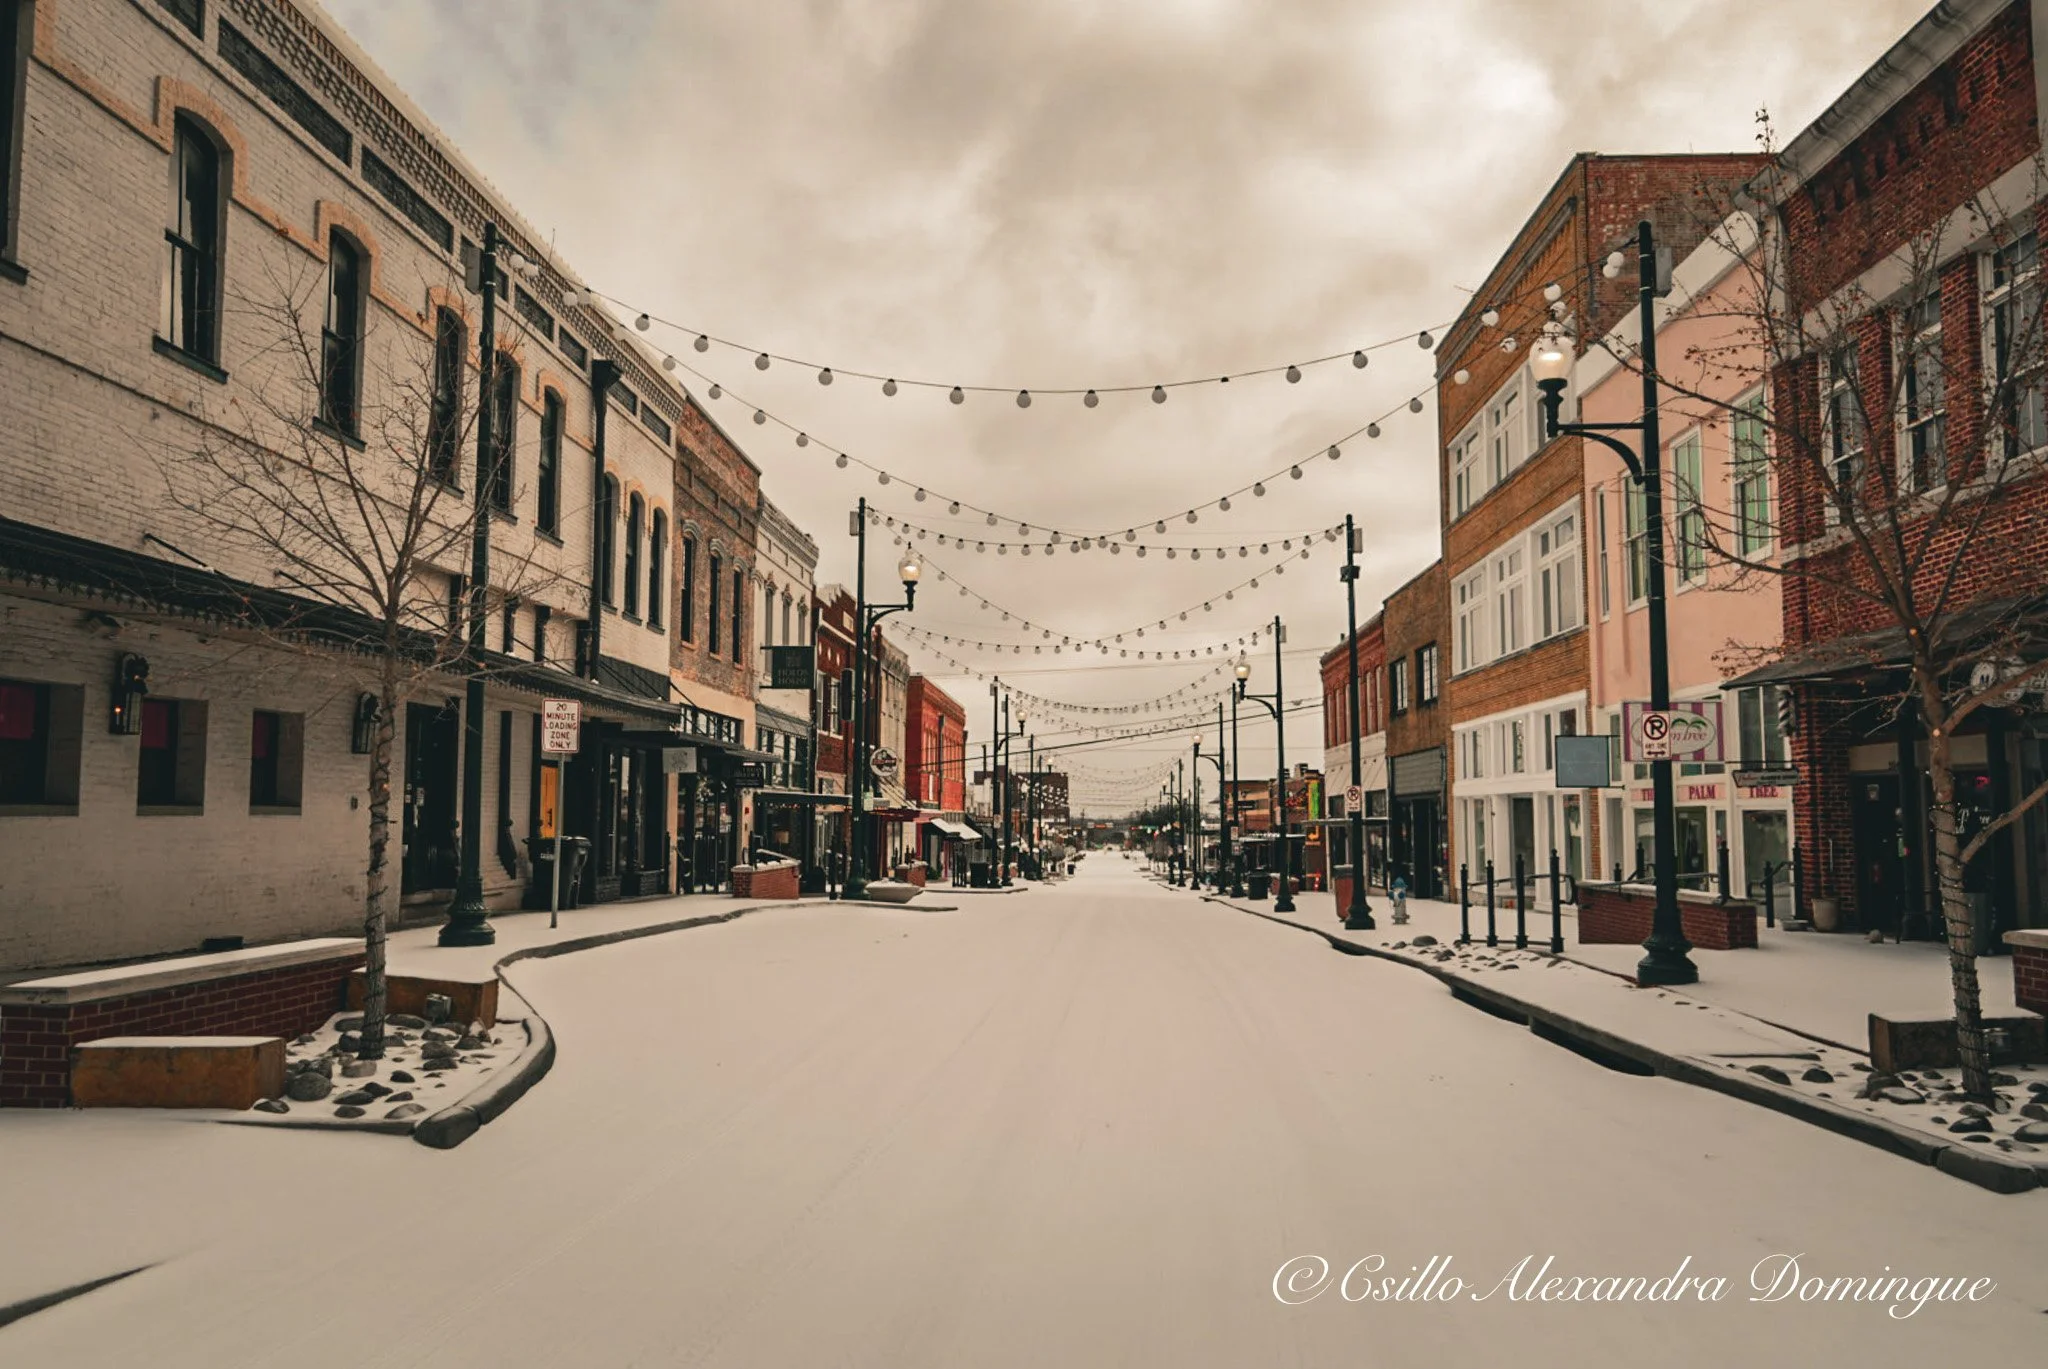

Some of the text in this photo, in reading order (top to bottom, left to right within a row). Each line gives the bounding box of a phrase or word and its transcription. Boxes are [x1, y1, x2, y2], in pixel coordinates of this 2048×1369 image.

[556, 702, 568, 711] 20
[546, 712, 576, 720] MINUTE
[544, 721, 577, 730] LOADING
[550, 731, 570, 739] ZONE
[549, 740, 571, 749] ONLY
[1642, 788, 1654, 801] TH
[1689, 785, 1716, 800] PALM
